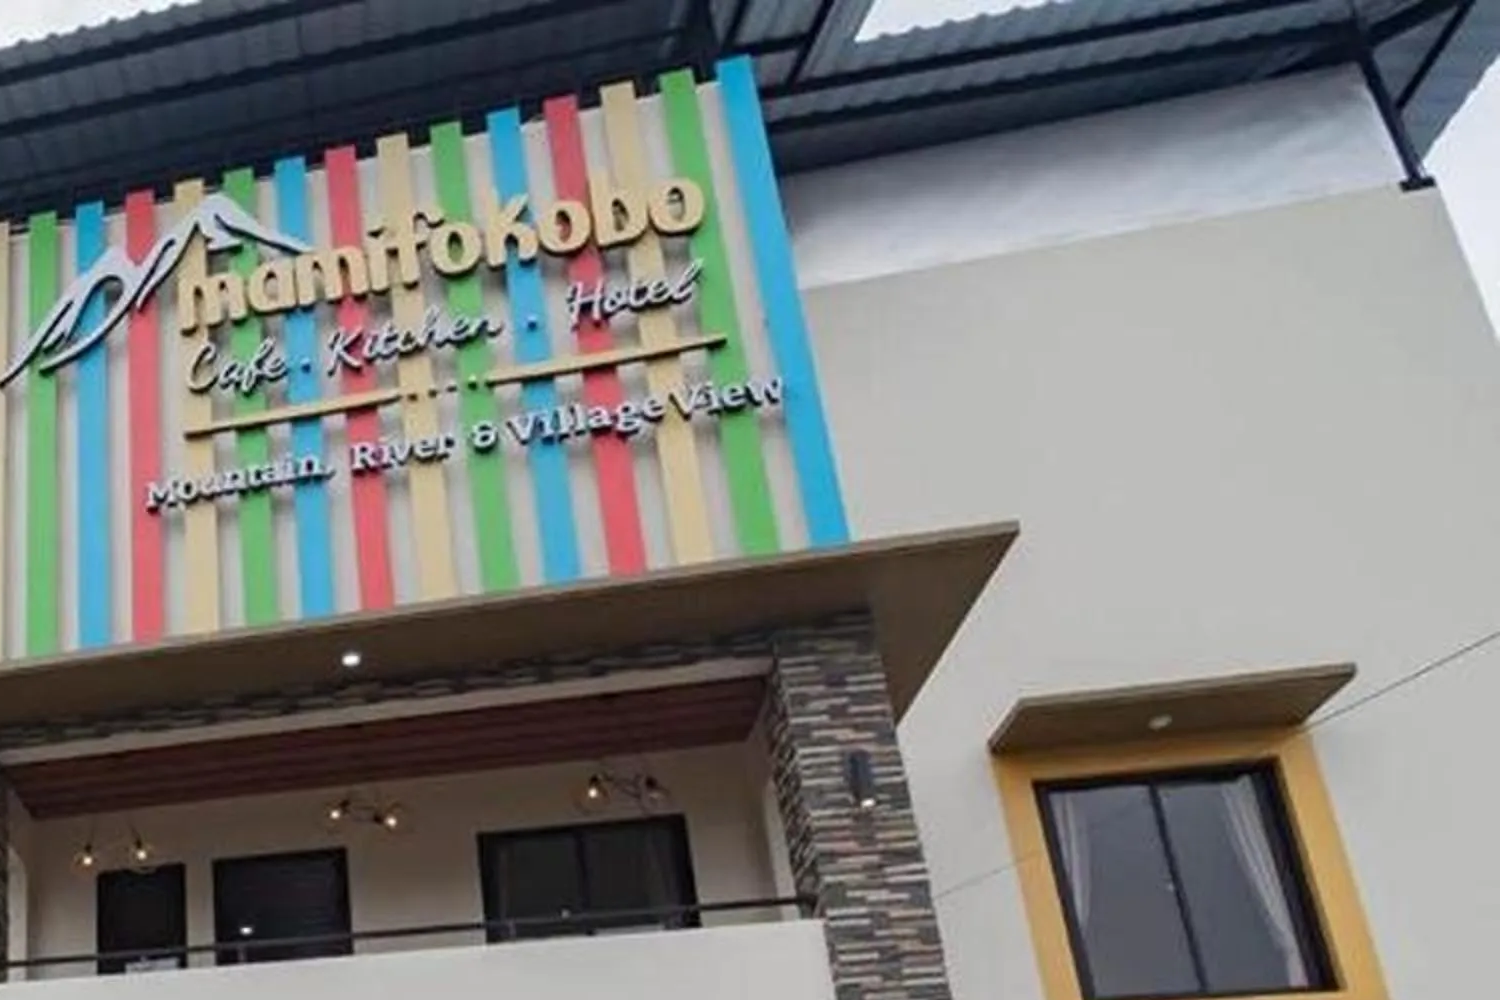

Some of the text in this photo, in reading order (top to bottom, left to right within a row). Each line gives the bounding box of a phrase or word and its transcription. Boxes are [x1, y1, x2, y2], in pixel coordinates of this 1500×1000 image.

[187, 257, 705, 395] Cafe Kitchen Hotel
[350, 430, 460, 474] River
[506, 394, 668, 445] Village
[667, 374, 785, 421] View
